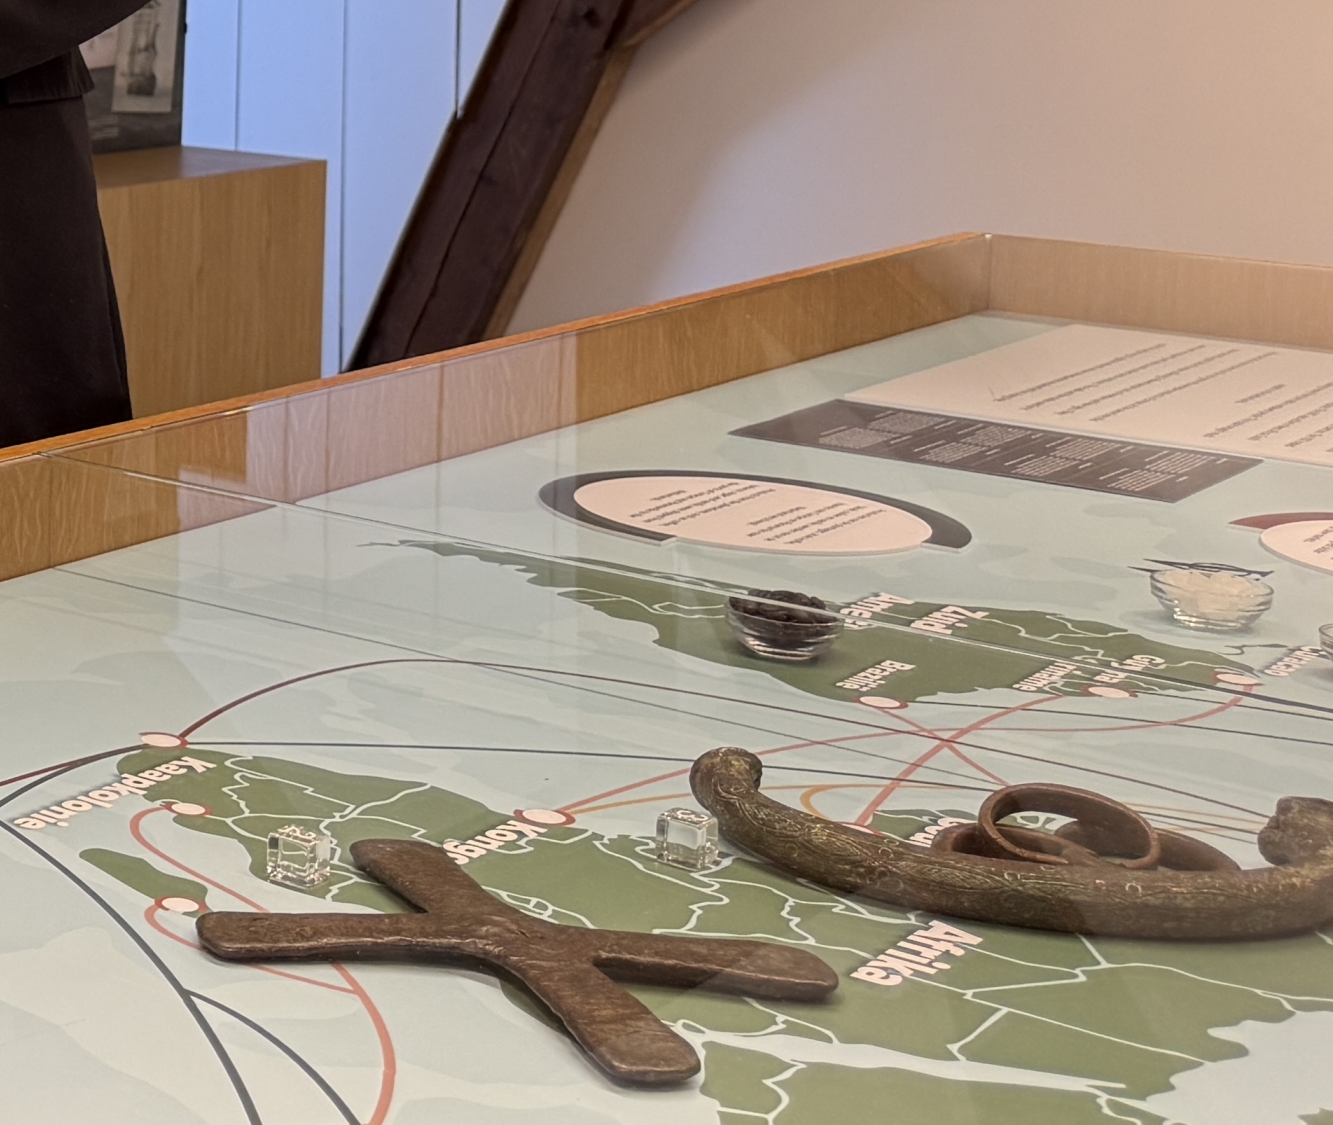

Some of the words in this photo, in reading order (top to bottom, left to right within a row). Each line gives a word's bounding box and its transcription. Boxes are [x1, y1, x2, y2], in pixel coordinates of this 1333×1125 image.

[910, 606, 990, 635] Zuid
[835, 660, 916, 692] Brazilië
[13, 756, 217, 830] Kaapkolonie
[850, 920, 984, 986] Afrika
